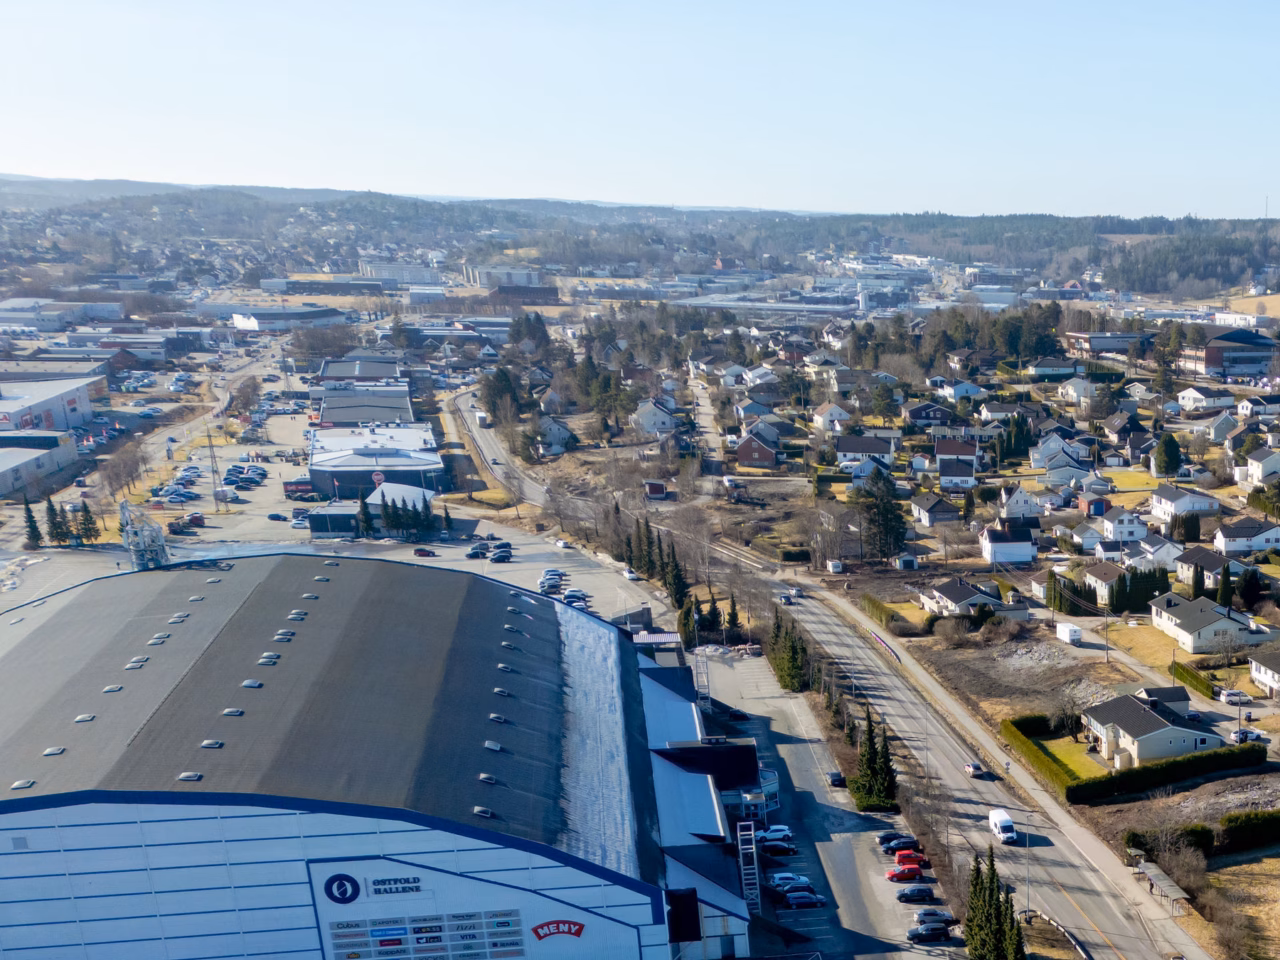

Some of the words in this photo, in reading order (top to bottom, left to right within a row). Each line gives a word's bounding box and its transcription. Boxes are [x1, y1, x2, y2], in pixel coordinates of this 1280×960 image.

[372, 877, 421, 886] ØSTFOLD
[373, 885, 422, 895] HALLENE
[336, 922, 360, 930] Cubus
[537, 923, 580, 936] MENY
